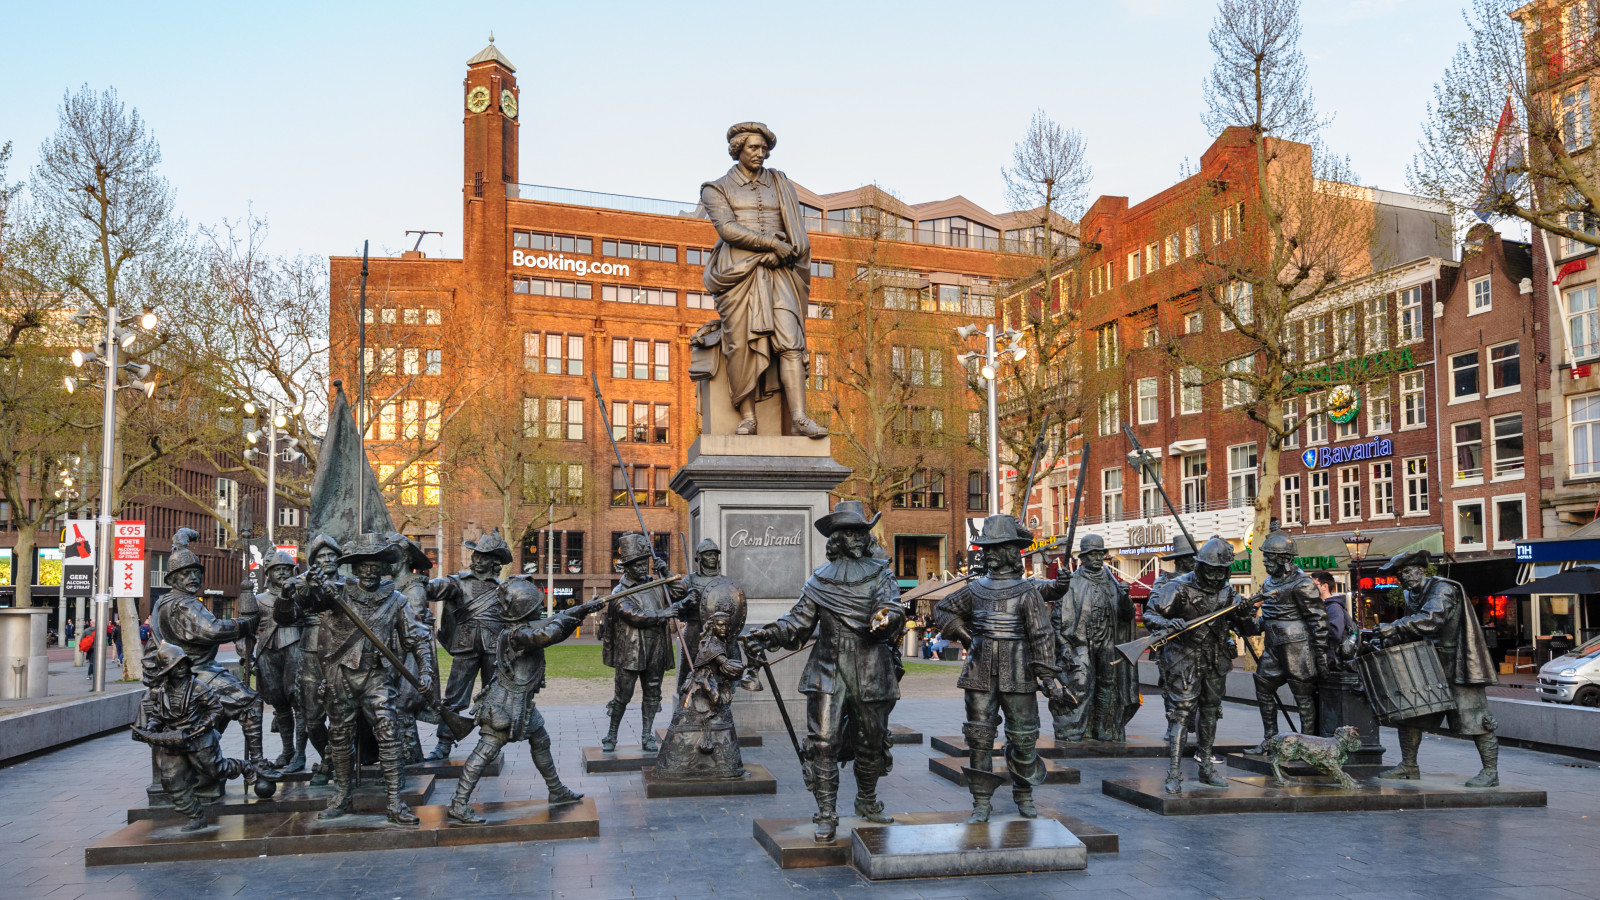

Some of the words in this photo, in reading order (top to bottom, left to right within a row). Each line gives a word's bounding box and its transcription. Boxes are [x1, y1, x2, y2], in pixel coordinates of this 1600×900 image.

[512, 249, 630, 277] Booking.com
[1319, 435, 1393, 468] Bavaria
[120, 526, 141, 535] €95
[1128, 517, 1166, 546] rain
[1137, 546, 1145, 556] grill
[1145, 544, 1167, 554] restaurant
